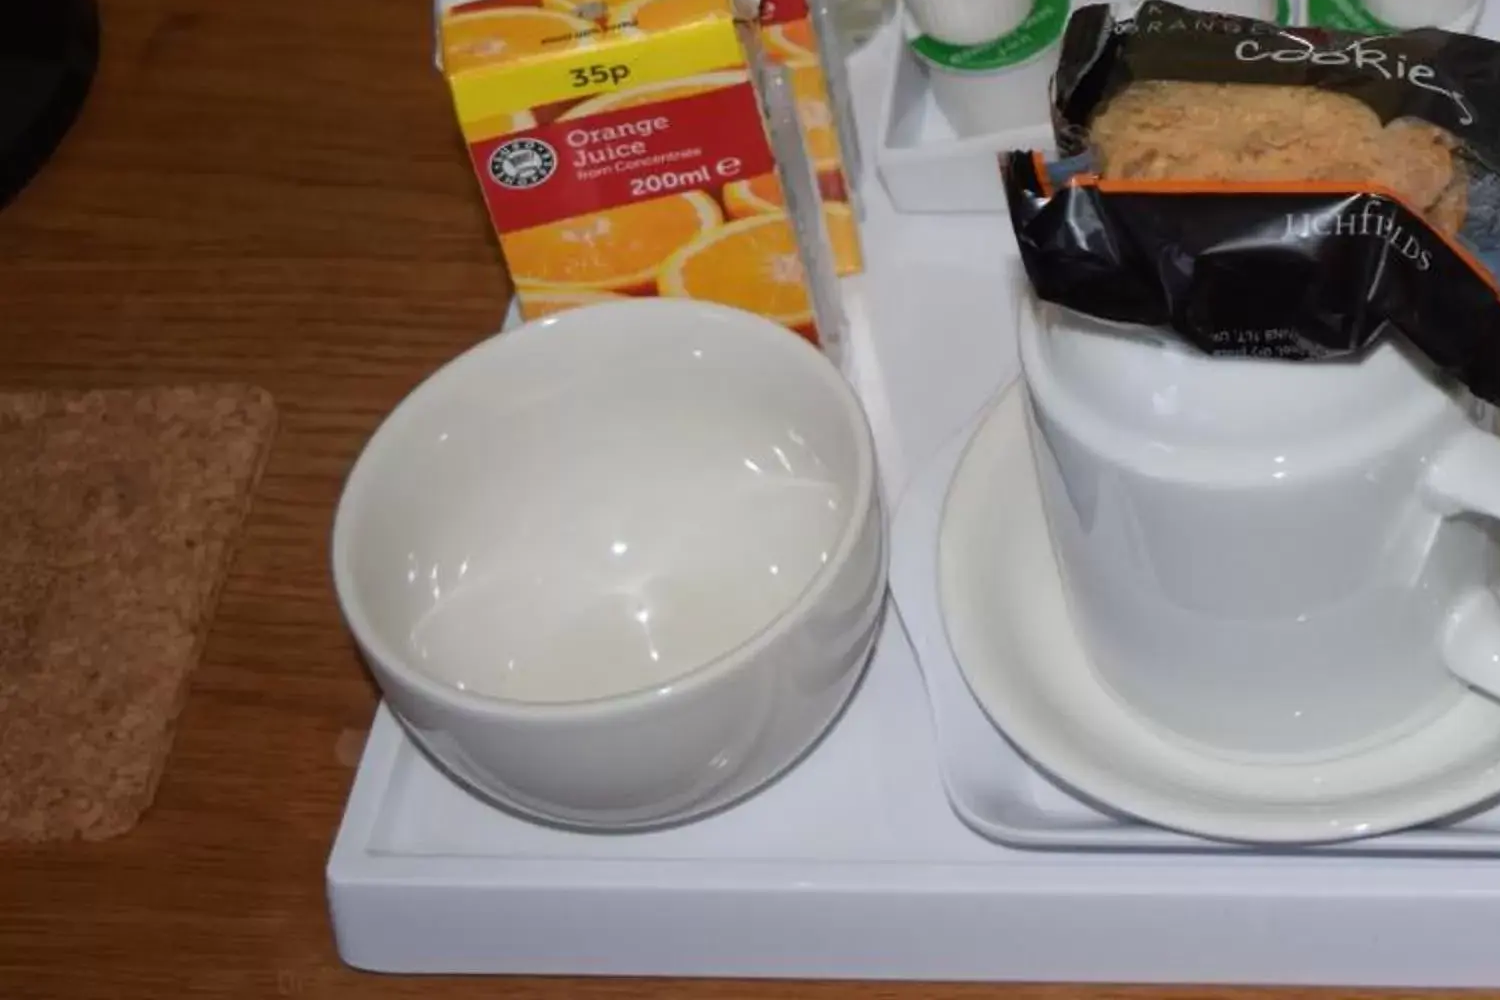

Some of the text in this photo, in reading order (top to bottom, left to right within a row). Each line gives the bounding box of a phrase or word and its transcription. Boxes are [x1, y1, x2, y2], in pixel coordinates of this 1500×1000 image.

[569, 61, 631, 89] 35p
[1235, 33, 1474, 126] cookies
[566, 115, 671, 149] Orange
[572, 138, 647, 169] Juice
[629, 164, 711, 197] 200ml
